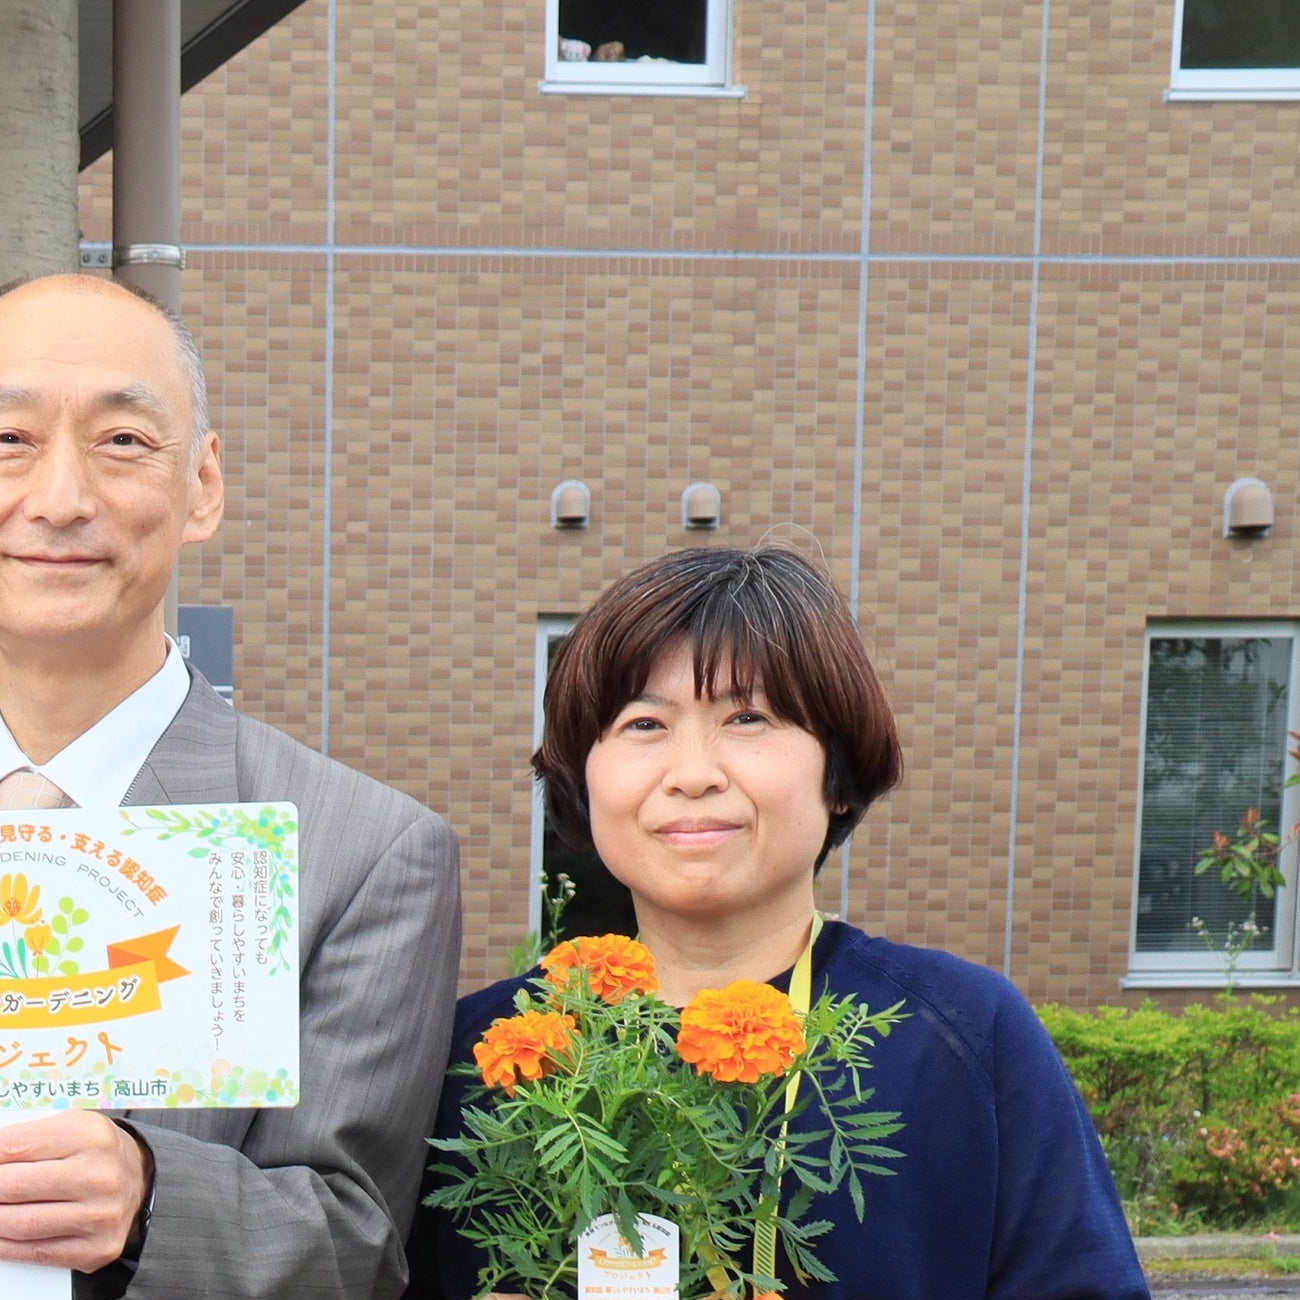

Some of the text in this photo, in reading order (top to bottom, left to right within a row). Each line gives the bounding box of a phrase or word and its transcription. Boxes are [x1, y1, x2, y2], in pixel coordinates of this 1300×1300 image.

[76, 863, 146, 919] PROJECT
[253, 850, 269, 965] 認知症になっても
[230, 851, 247, 1023] 安心・暮らしやすいまちを
[113, 1079, 169, 1098] 高山市
